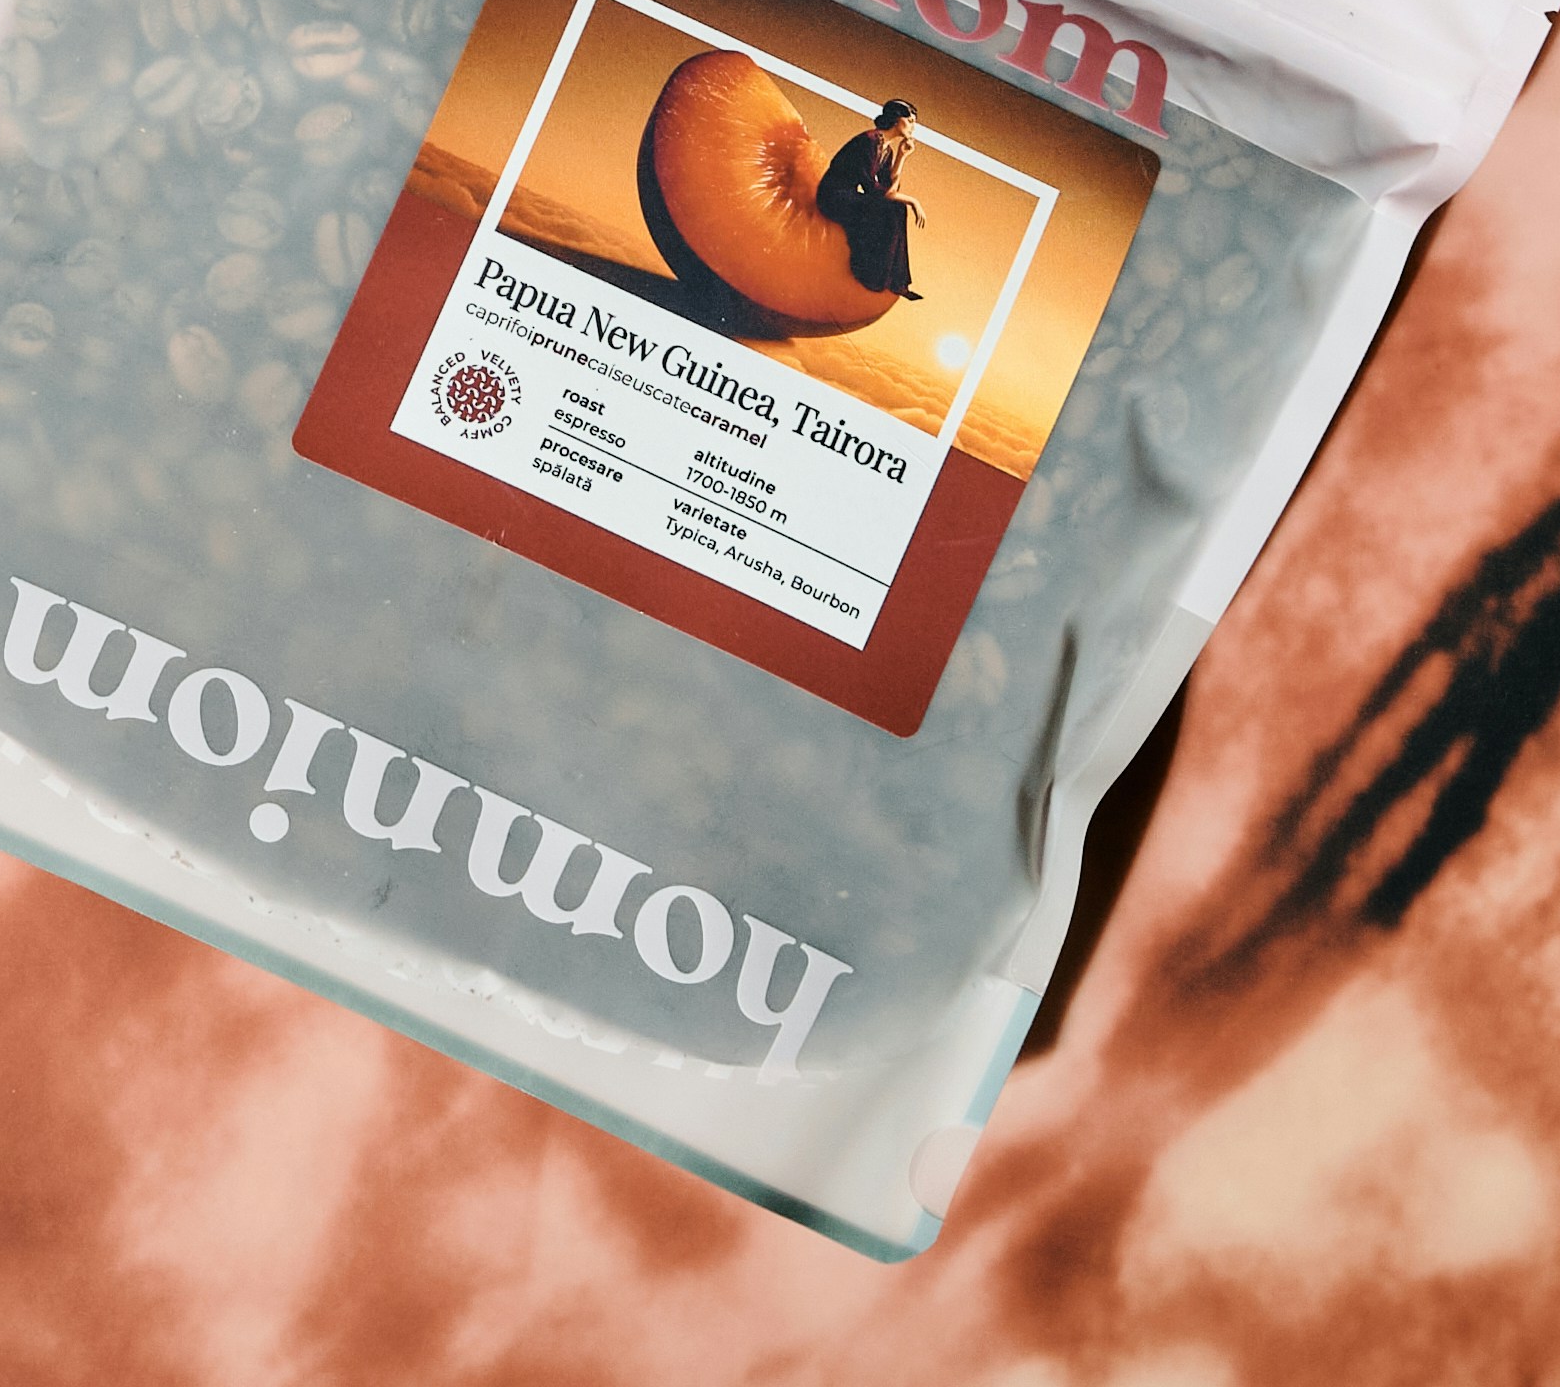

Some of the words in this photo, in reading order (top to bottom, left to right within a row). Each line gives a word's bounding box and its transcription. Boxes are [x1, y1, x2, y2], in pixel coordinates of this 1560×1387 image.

[430, 352, 465, 426] BALANCED
[474, 257, 576, 328] Papua
[580, 306, 659, 362] New
[662, 345, 779, 428] Guinea,
[792, 401, 907, 484] Tairora
[481, 349, 521, 405] VELVETY
[562, 389, 605, 416] roast
[460, 415, 512, 439] COMFY
[554, 409, 626, 448] espresso
[532, 457, 592, 492] spălată
[540, 437, 623, 482] procesare
[694, 450, 776, 495] altitudine
[687, 467, 767, 513] 1700-1850
[770, 509, 787, 525] m
[674, 498, 747, 540] varietate
[666, 515, 719, 555] Typica,
[723, 546, 785, 585] Arusha,
[790, 575, 860, 619] Bourbon
[2, 576, 853, 1080] homniom
